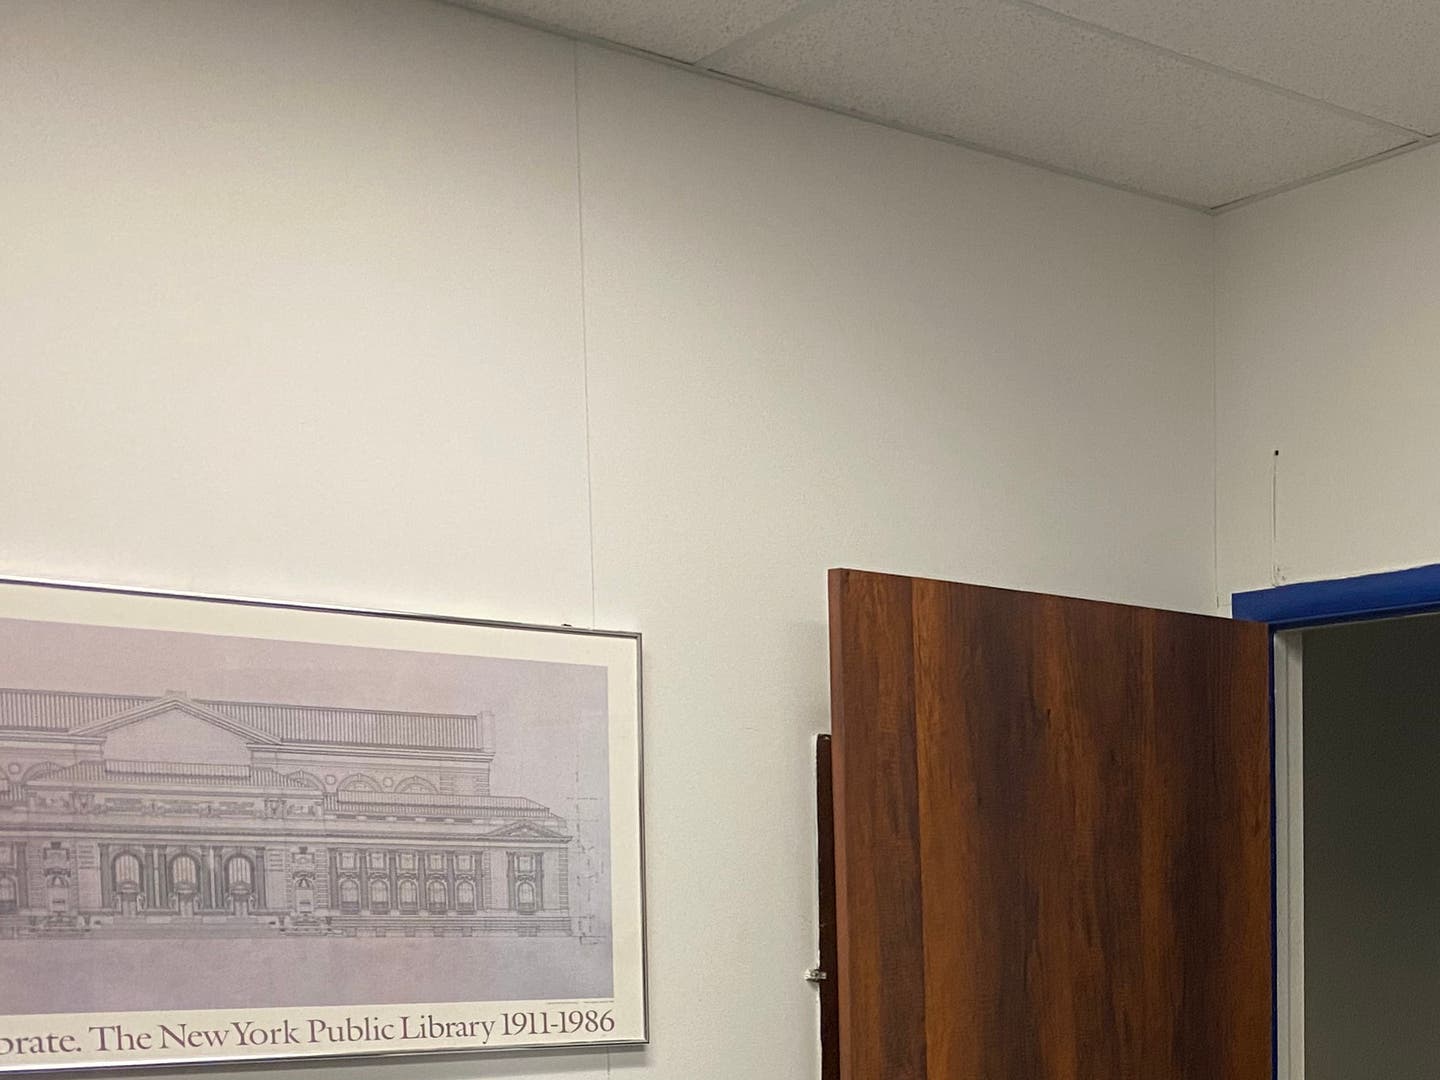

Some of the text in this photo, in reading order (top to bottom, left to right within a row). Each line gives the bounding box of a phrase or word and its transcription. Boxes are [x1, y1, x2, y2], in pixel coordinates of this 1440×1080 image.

[89, 1025, 151, 1051] The
[158, 1023, 229, 1048] New
[230, 1019, 300, 1046] York
[308, 1017, 394, 1043] Public
[399, 1014, 495, 1044] Library
[501, 1009, 615, 1035] 1911-1986
